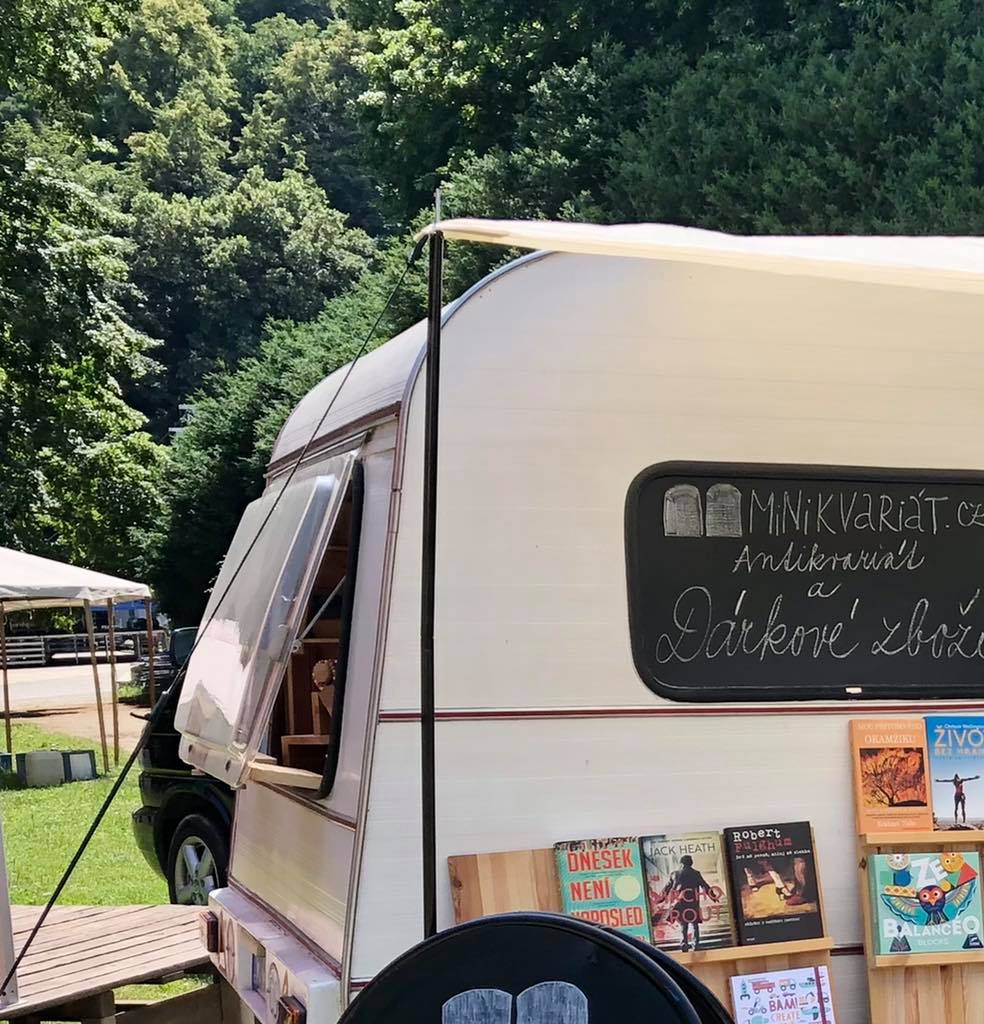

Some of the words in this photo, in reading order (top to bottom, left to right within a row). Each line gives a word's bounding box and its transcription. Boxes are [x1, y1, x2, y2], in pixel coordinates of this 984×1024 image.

[732, 540, 924, 573] Antikvariát
[808, 581, 841, 597] a
[656, 586, 859, 664] Dárkové
[733, 828, 781, 842] Robert
[649, 845, 677, 857] JACK
[679, 842, 716, 855] HEATH
[882, 915, 981, 938] BALANCEO
[769, 997, 798, 1012] BAM!
